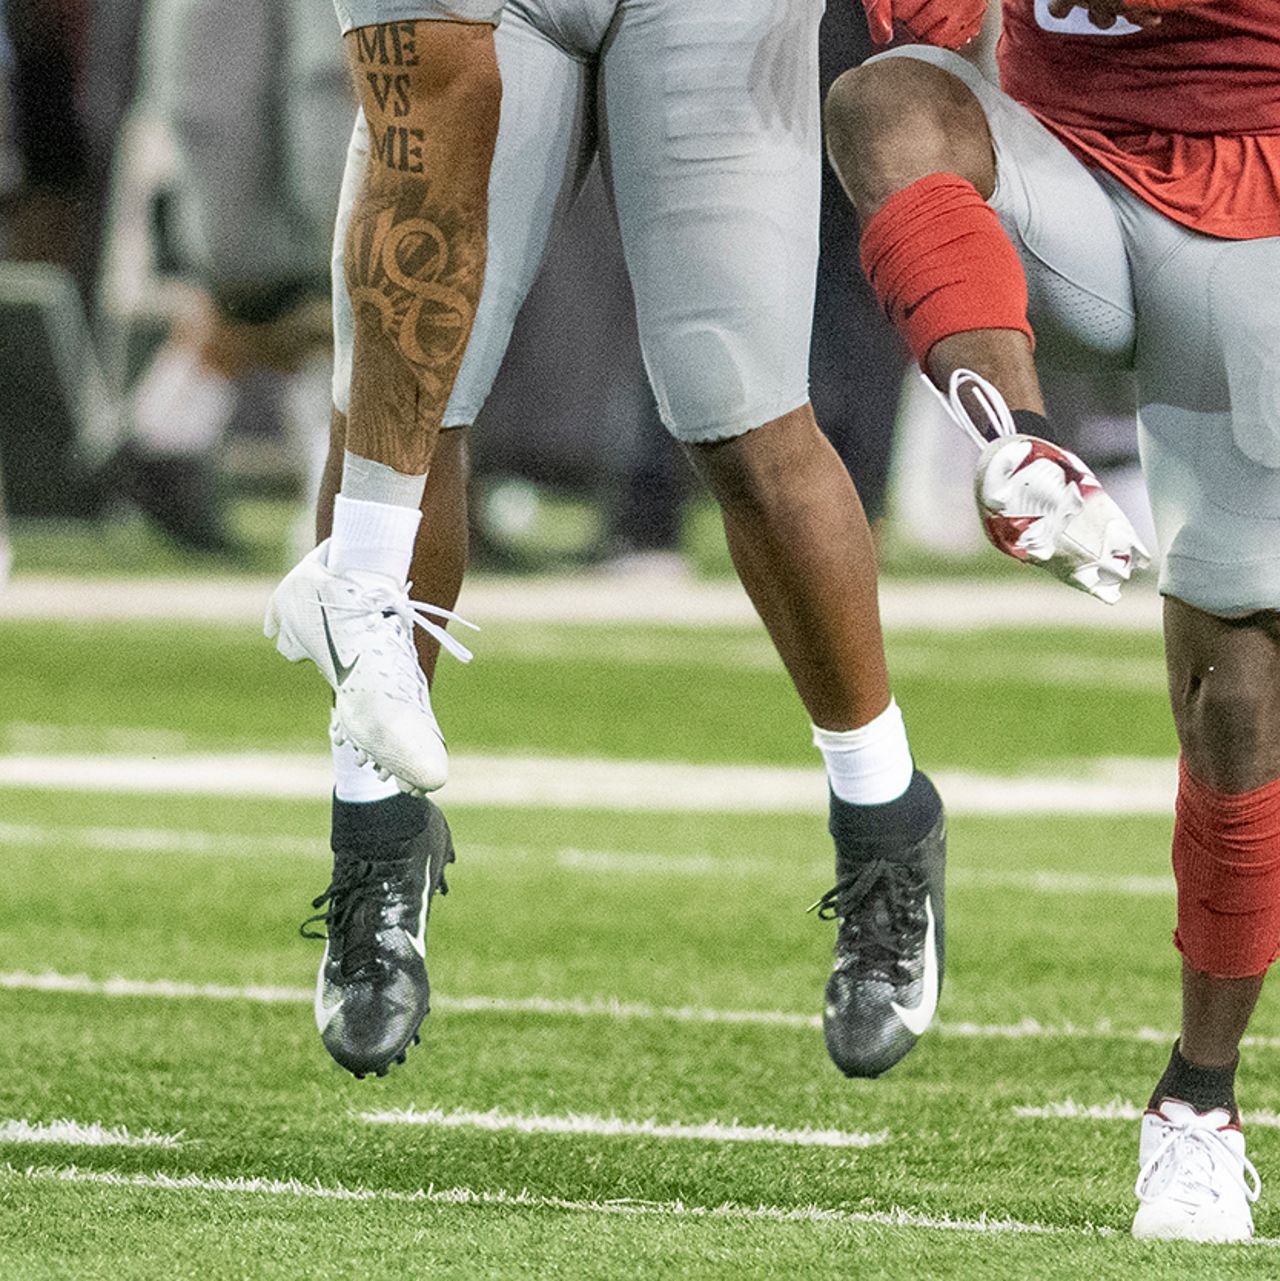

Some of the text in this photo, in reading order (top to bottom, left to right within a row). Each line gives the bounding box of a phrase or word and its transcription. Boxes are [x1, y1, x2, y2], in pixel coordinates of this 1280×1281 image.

[356, 22, 419, 67] ME
[366, 73, 411, 117] VS
[369, 122, 425, 173] ME
